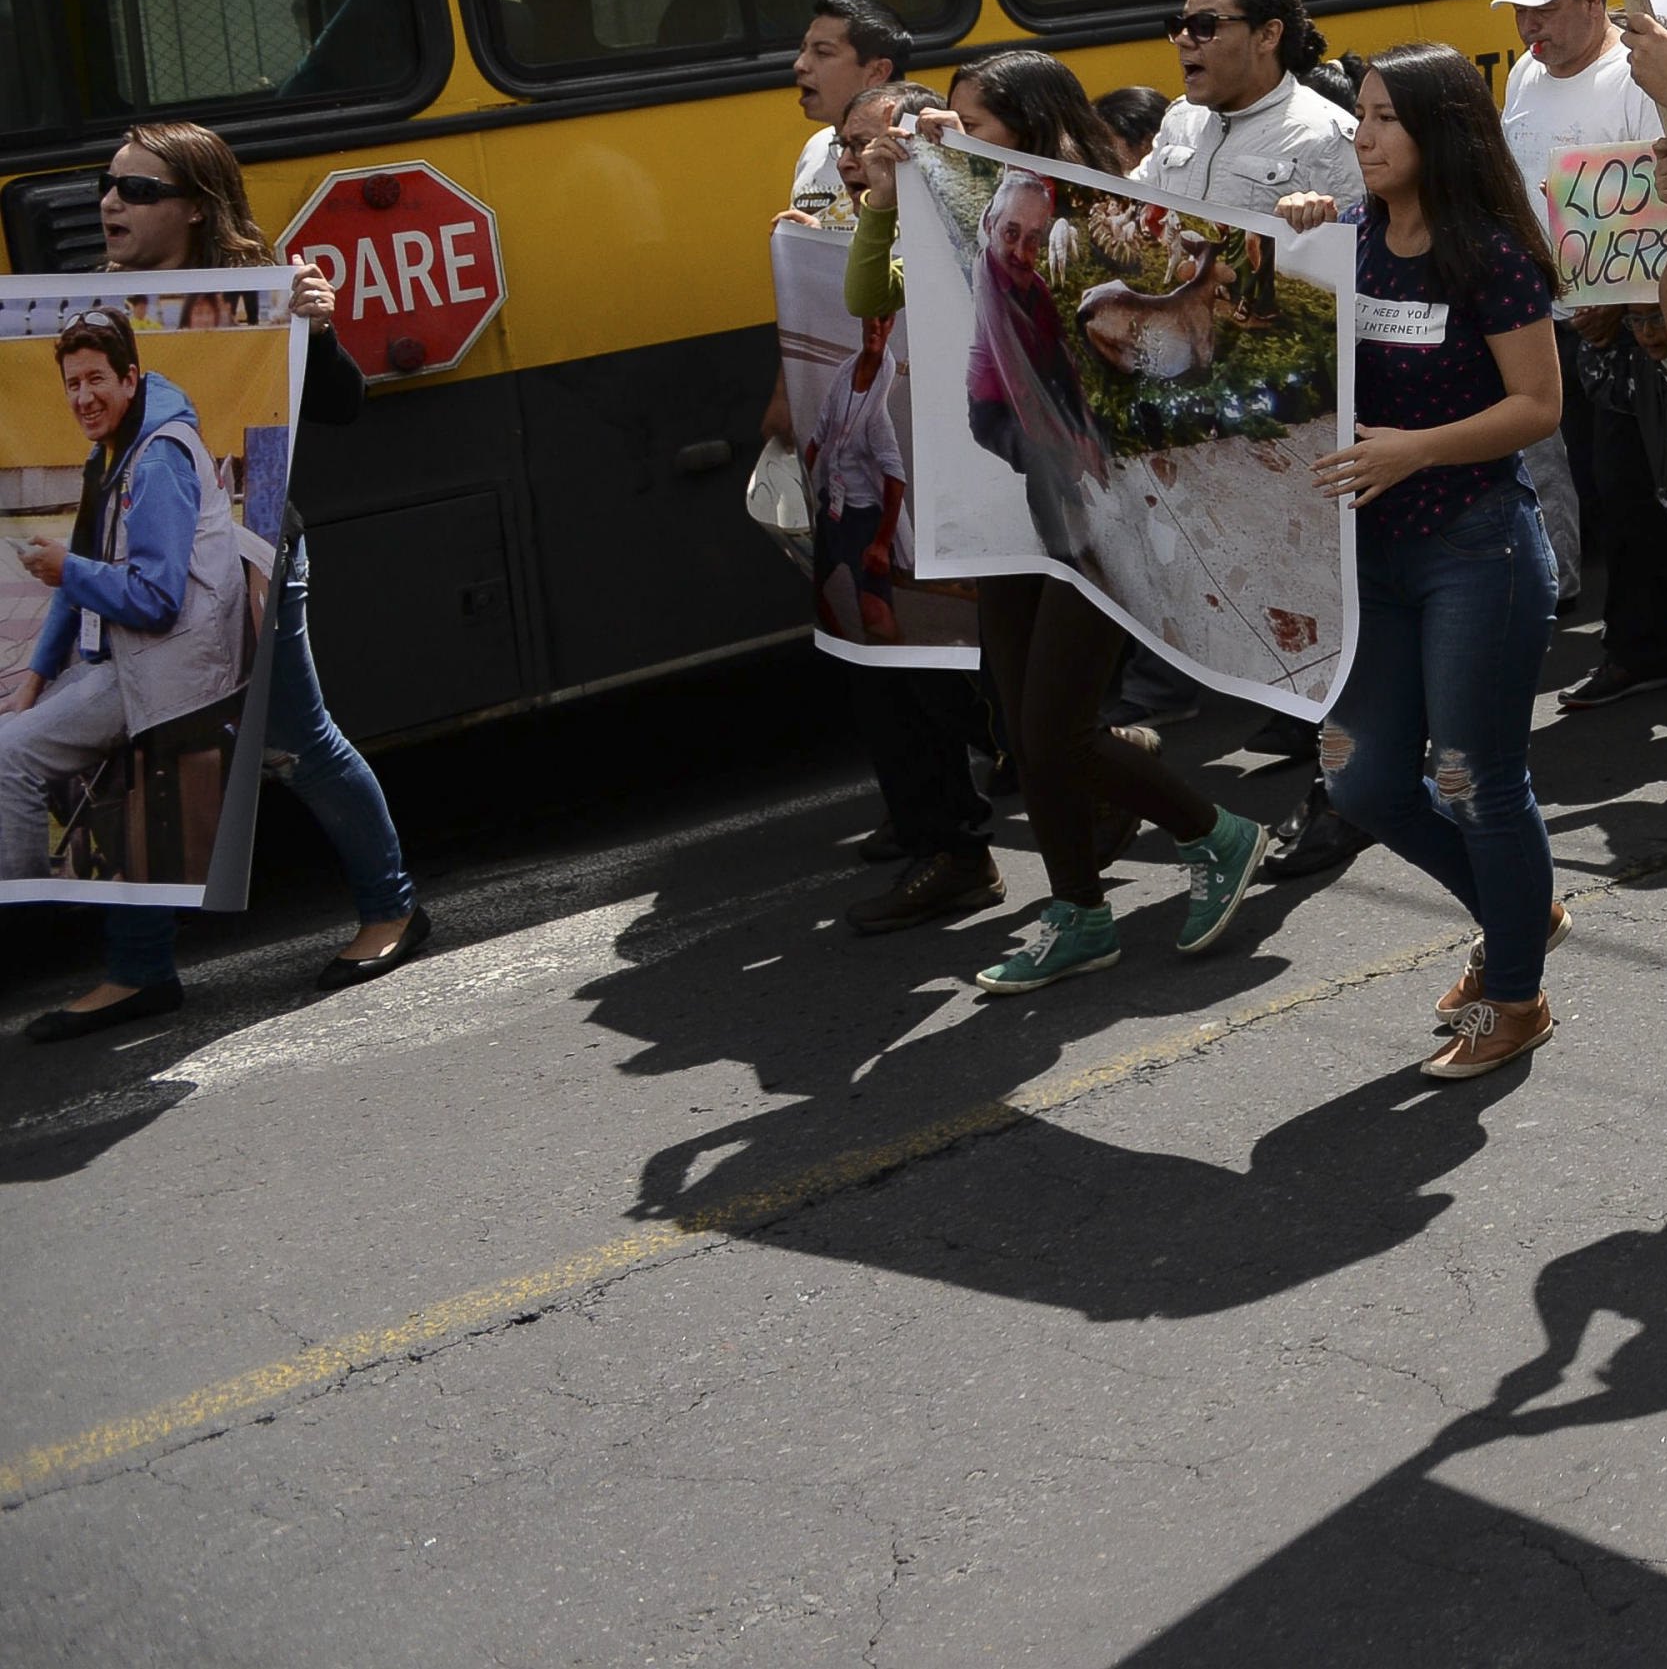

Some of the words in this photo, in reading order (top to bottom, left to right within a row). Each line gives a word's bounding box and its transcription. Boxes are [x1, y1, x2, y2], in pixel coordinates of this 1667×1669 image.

[1564, 154, 1654, 220] LOS
[303, 221, 487, 320] PARE
[1362, 321, 1428, 336] INTERNET!
[1373, 307, 1400, 319] NEED
